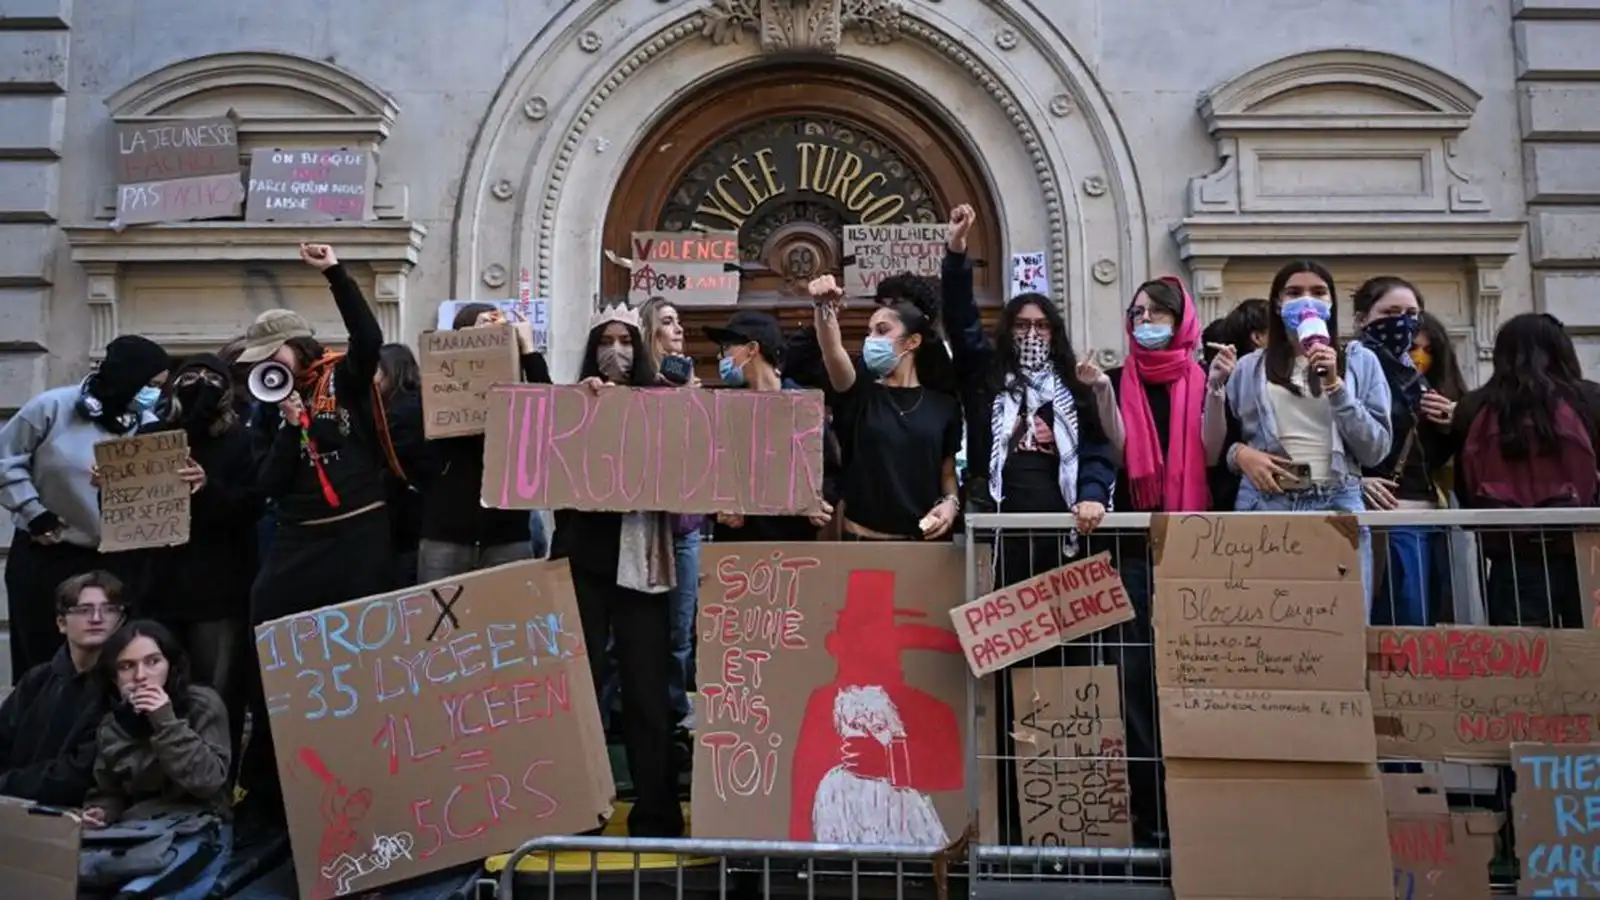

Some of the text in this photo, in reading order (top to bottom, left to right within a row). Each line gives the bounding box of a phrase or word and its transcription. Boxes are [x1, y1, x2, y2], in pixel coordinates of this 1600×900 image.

[119, 123, 238, 154] LA JEUNESSE
[121, 183, 161, 213] PAS
[796, 142, 912, 226] TURGO
[848, 228, 868, 241] ILS
[701, 603, 808, 649] JEUNE
[964, 595, 1016, 636] PAS
[1015, 580, 1053, 611] DE
[971, 585, 1129, 668] PAS DE SILENCE
[722, 646, 771, 688] ET
